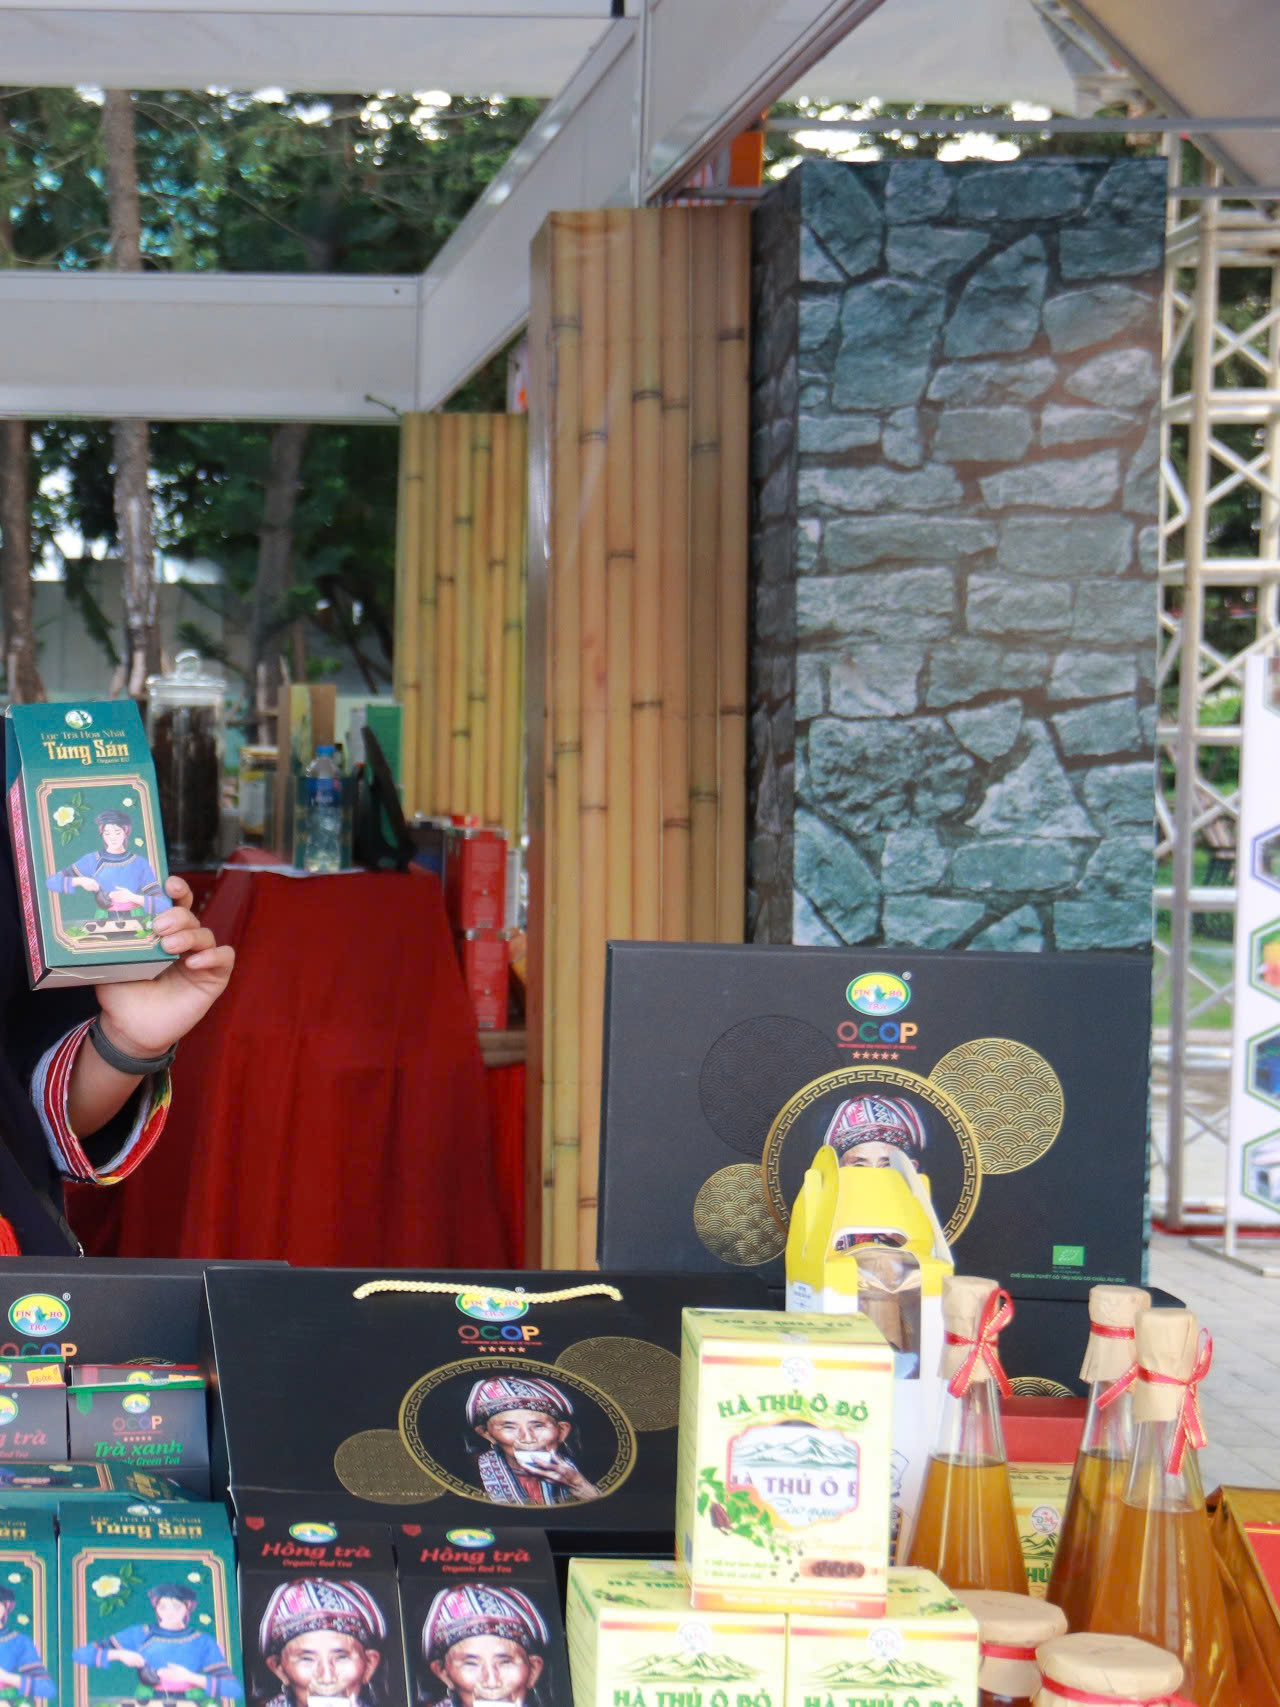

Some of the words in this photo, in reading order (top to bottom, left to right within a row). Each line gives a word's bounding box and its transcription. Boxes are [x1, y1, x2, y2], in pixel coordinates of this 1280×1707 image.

[43, 740, 92, 766] Túng
[93, 739, 129, 757] Sán
[837, 1020, 918, 1044] OCOP
[458, 1324, 540, 1342] OCOP
[0, 1342, 78, 1363] OCOP
[717, 1393, 752, 1418] HÀ
[757, 1389, 803, 1412] THỦ
[810, 1393, 828, 1412] Ô
[834, 1399, 869, 1421] ĐỎ
[112, 1415, 163, 1430] OCOP
[13, 1428, 48, 1445] trà
[94, 1440, 127, 1457] Trà
[131, 1439, 184, 1456] xanh
[136, 1456, 162, 1466] Green
[164, 1455, 181, 1465] Tea
[764, 1473, 811, 1496] THỦ
[820, 1475, 839, 1497] Ô
[261, 1541, 326, 1560] Hồng
[334, 1545, 371, 1559] trà
[420, 1546, 486, 1566] Hồng
[493, 1548, 531, 1563] trà
[613, 1686, 645, 1707] HÀ
[656, 1686, 702, 1707] THỦ
[710, 1689, 729, 1707] Ô
[736, 1688, 772, 1707] ĐỎ
